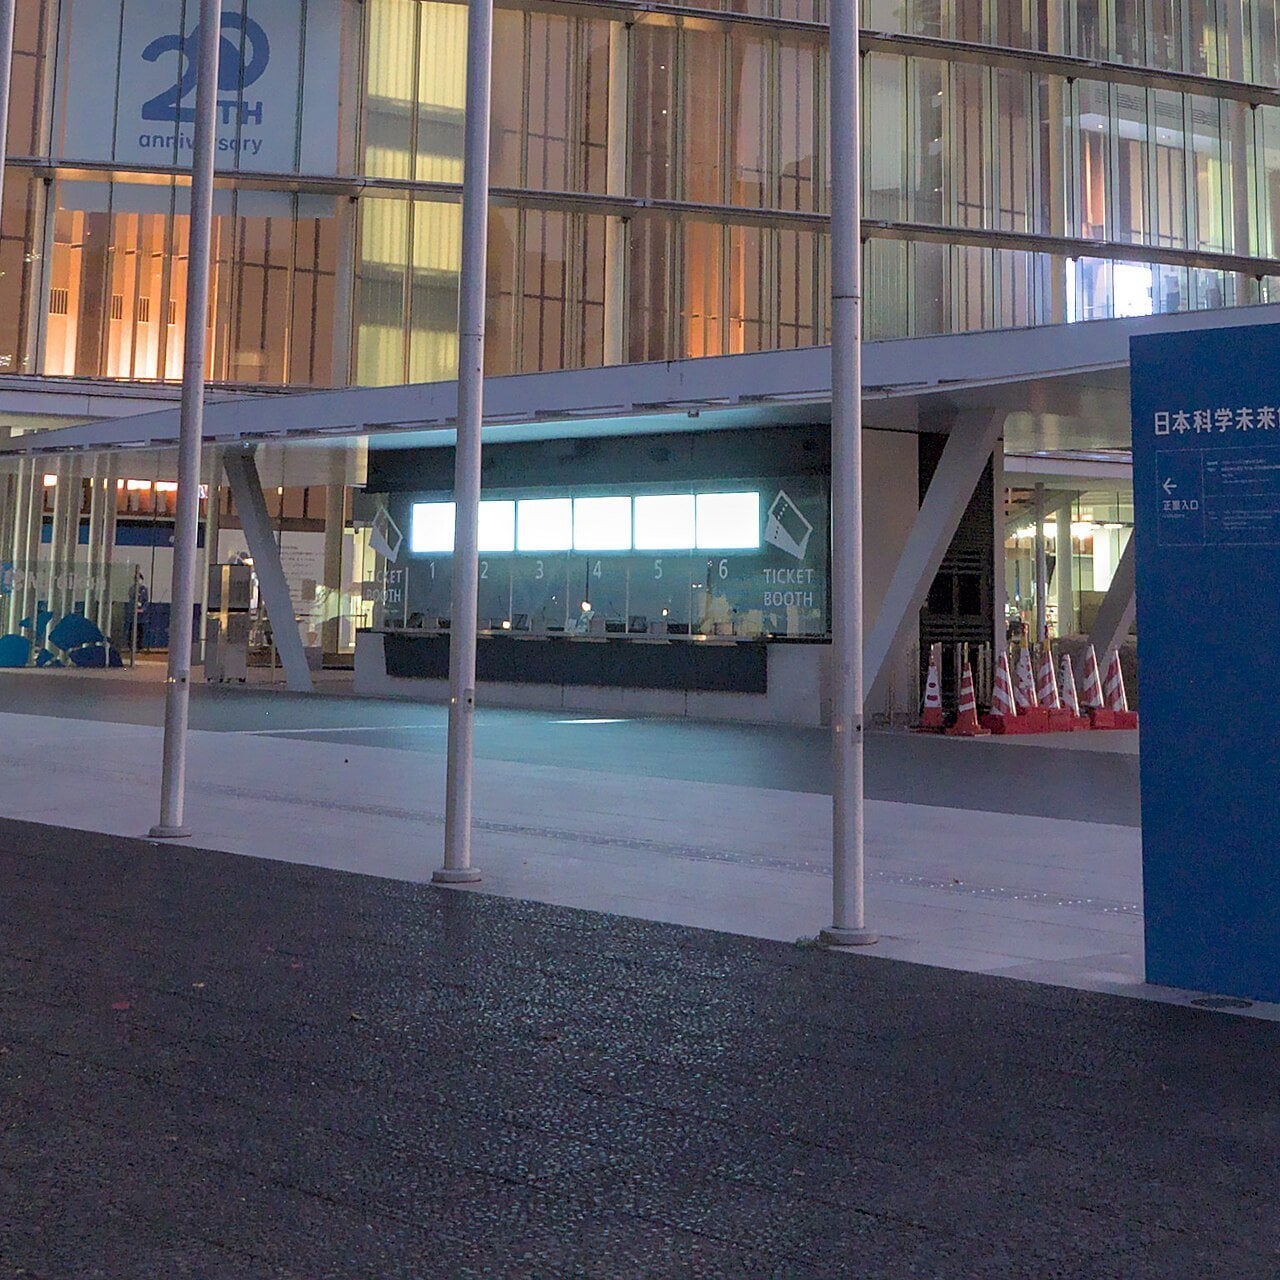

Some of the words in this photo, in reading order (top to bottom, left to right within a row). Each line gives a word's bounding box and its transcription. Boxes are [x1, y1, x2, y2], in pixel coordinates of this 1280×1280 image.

[138, 133, 263, 155] annivsary
[429, 562, 435, 579] 1
[480, 561, 489, 579] 2
[535, 560, 545, 580] 3
[592, 561, 602, 580] 4
[654, 559, 663, 580] 5
[718, 559, 728, 580] 6
[763, 568, 814, 585] TICKET
[763, 591, 813, 607] BOOTH
